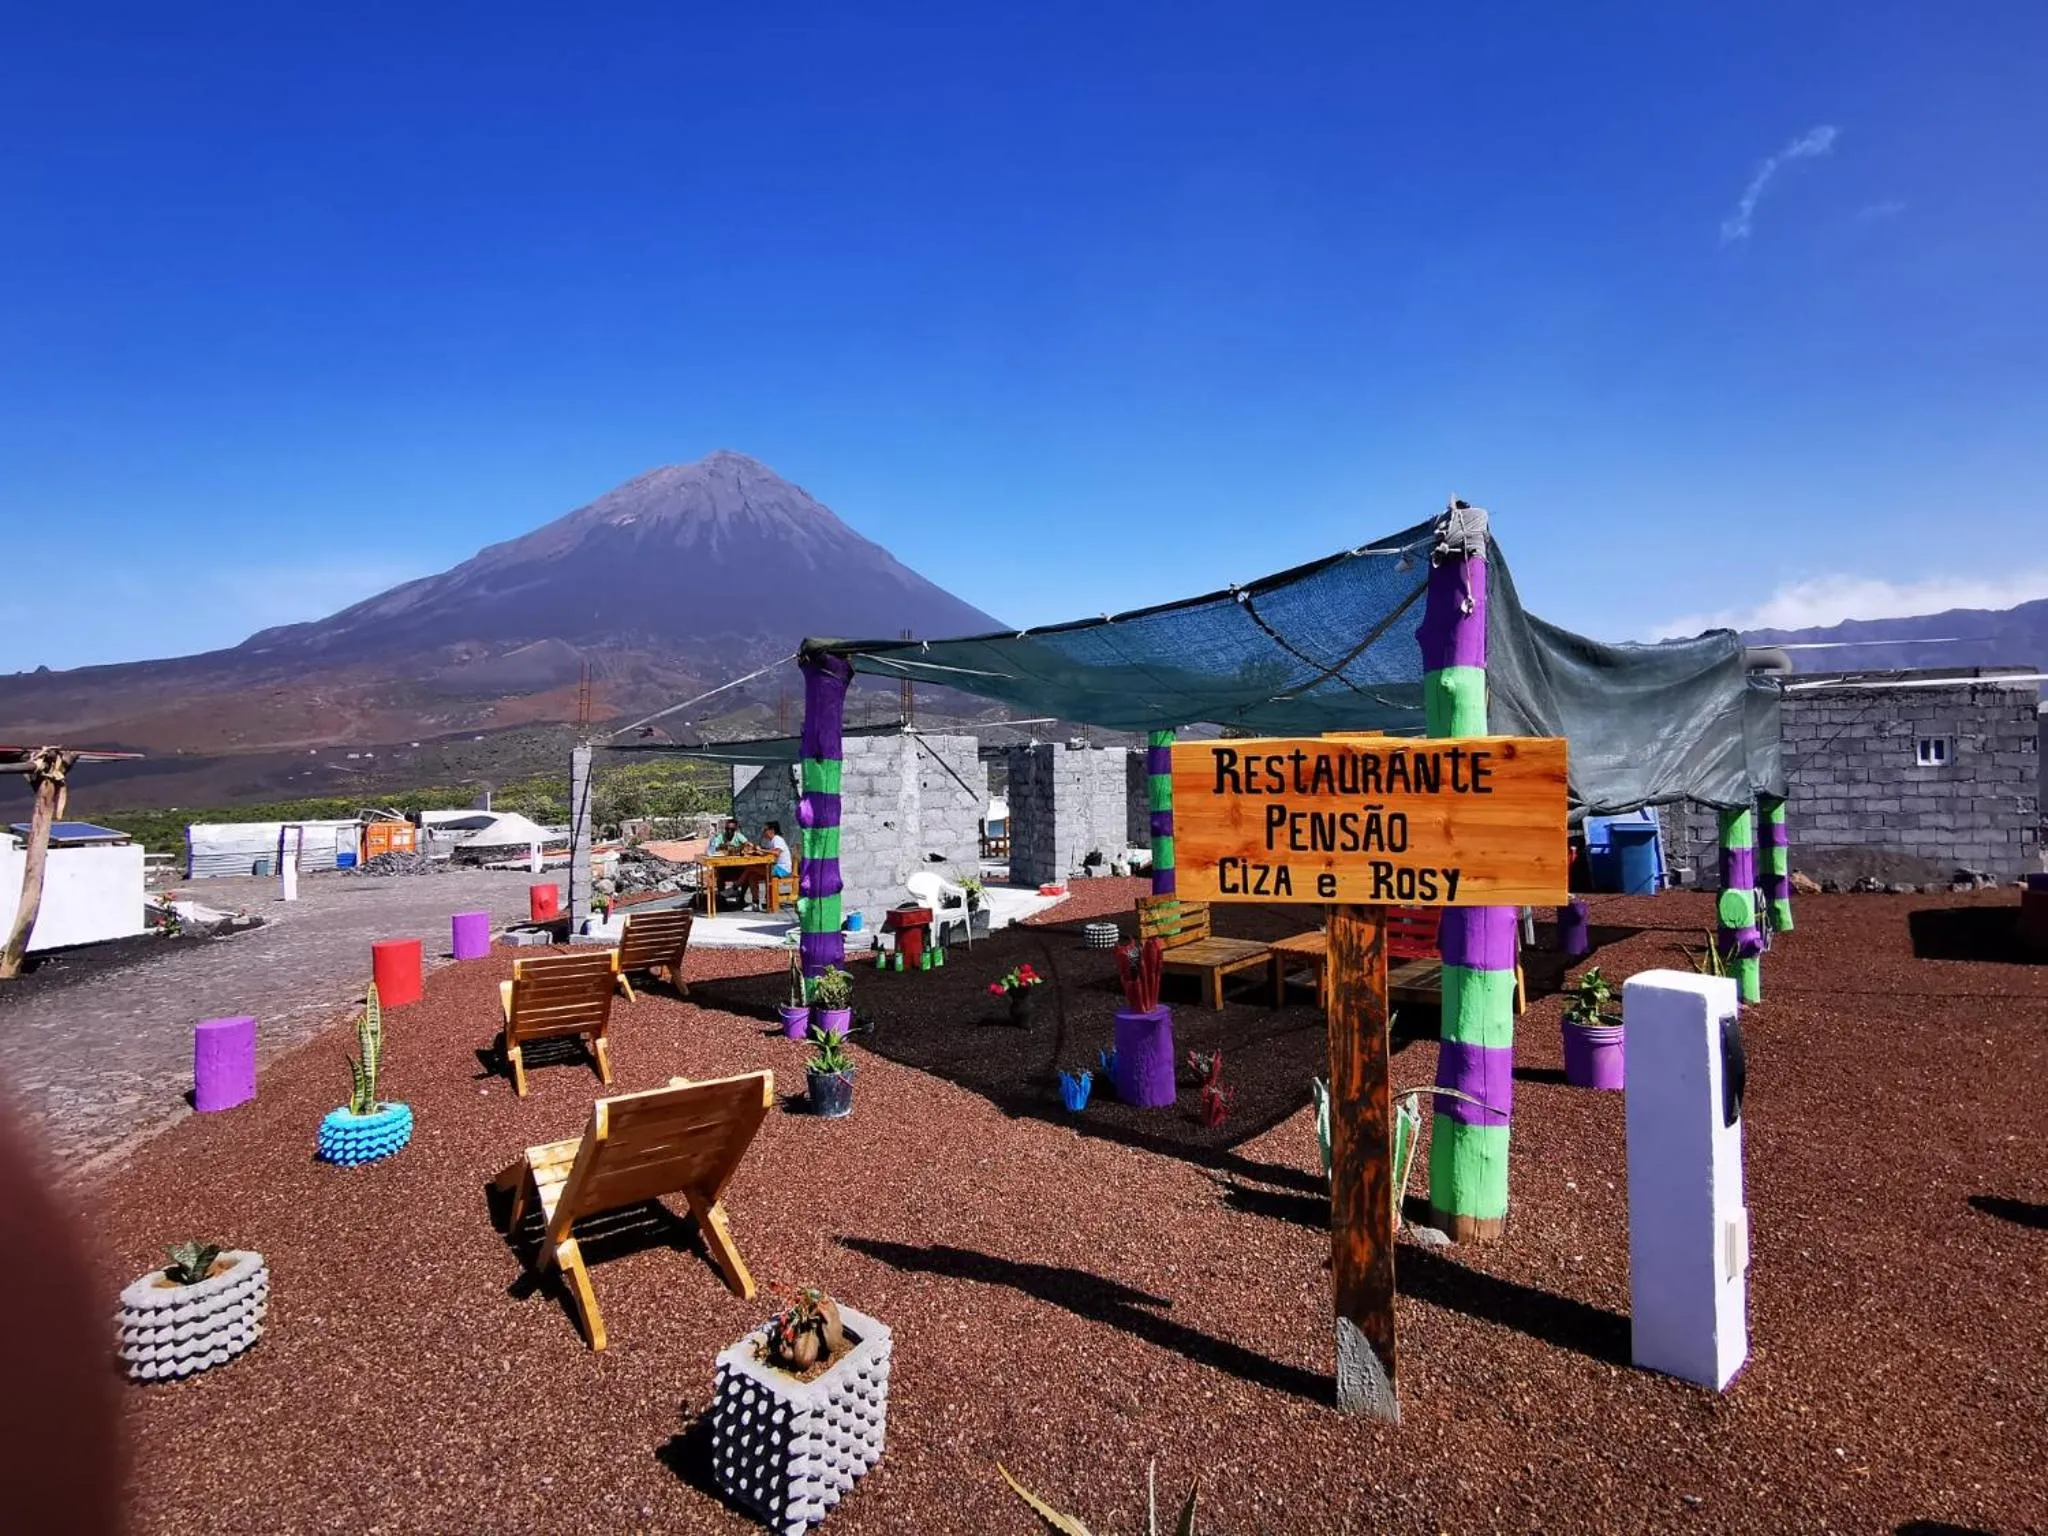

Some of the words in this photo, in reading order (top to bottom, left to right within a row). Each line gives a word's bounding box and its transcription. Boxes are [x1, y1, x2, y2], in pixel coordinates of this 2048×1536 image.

[1266, 804, 1408, 853] PENSÃO
[1317, 874, 1337, 898] e
[1368, 861, 1461, 902] ROSY
